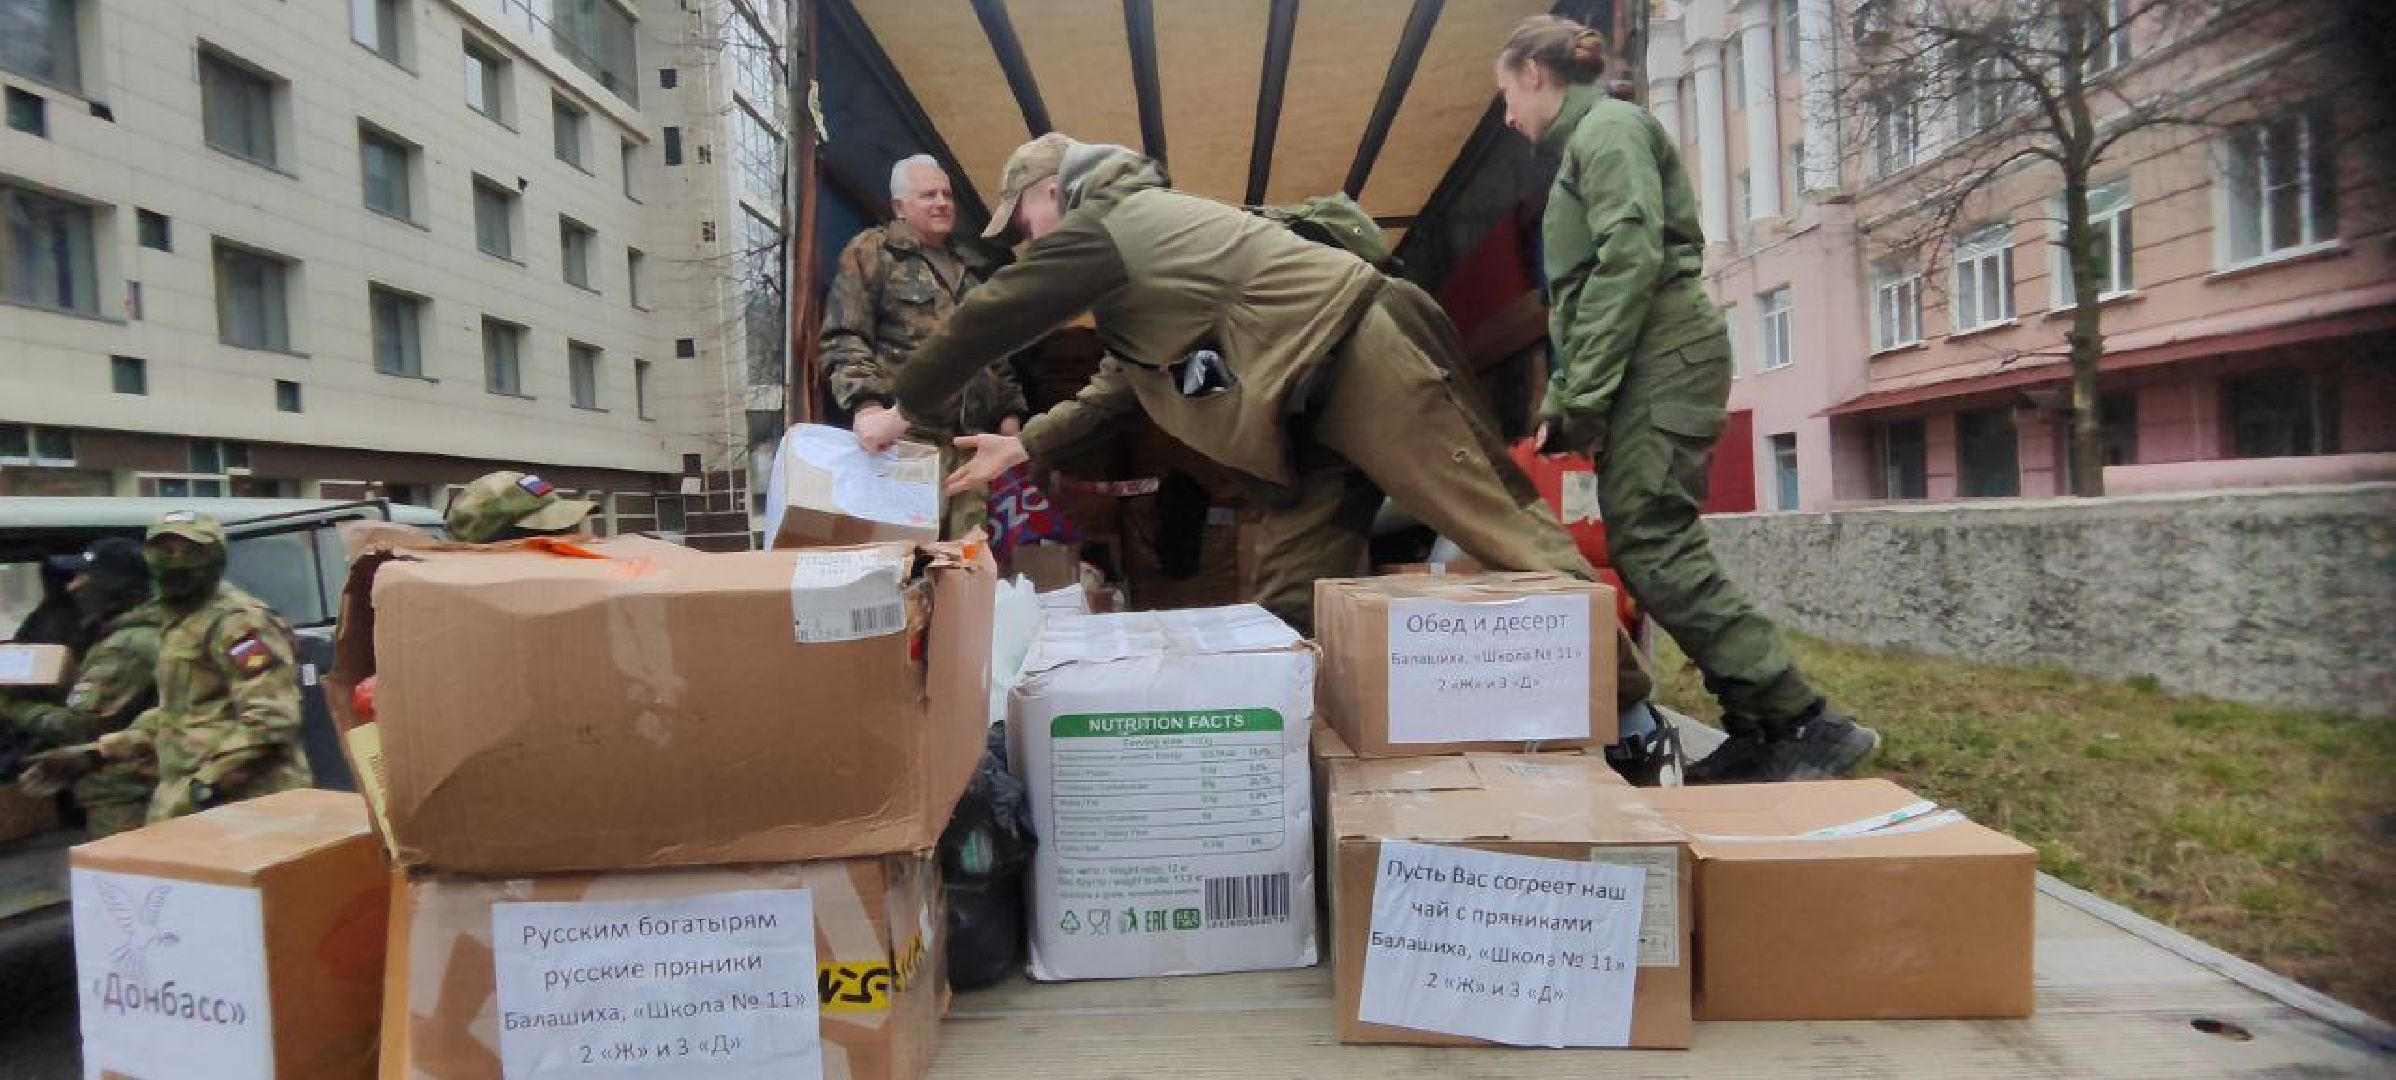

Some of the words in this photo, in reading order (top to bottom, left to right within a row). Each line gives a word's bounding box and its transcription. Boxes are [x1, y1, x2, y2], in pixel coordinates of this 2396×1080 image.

[1406, 613, 1467, 636] Обед
[1474, 617, 1488, 631] и
[1492, 613, 1568, 635] десерт
[1474, 648, 1532, 663] «Школа
[1535, 647, 1553, 661] №
[1557, 645, 1583, 659] 11»
[1437, 678, 1447, 690] 2
[1451, 677, 1481, 690] «Ж»
[1487, 678, 1496, 689] и
[1499, 676, 1508, 689] 3
[1512, 675, 1540, 689] «Д»
[1088, 716, 1184, 732] NUTRITION
[1188, 714, 1244, 729] FACTS
[1387, 859, 1446, 886] Пусть
[1452, 866, 1488, 888] Вас
[1493, 874, 1578, 896] согреет
[1582, 884, 1626, 901] наш
[522, 919, 630, 948] Русским
[639, 911, 777, 937] богатырям
[1410, 900, 1450, 920] чай
[1456, 905, 1466, 921] с
[1472, 908, 1593, 933] пряниками
[1371, 931, 1473, 961] Балашиха,
[1479, 942, 1557, 968] «Школа
[1563, 951, 1585, 969] №
[1591, 953, 1626, 973] 11»
[544, 962, 645, 991] русские
[655, 953, 762, 979] пряники
[1427, 972, 1438, 989] 2
[1444, 976, 1485, 994] «Ж»
[1492, 983, 1504, 997] и
[1509, 982, 1520, 999] 3
[1528, 983, 1564, 1004] «Д»
[92, 972, 247, 1025] «Донбасс»
[504, 1006, 626, 1031] Балашиха,
[633, 1000, 724, 1020] «Школа
[732, 993, 759, 1011] №
[767, 990, 806, 1009] 11»
[580, 1045, 593, 1064] 2
[600, 1041, 649, 1061] «Ж»
[656, 1041, 671, 1058] и
[678, 1037, 690, 1056] 3
[699, 1034, 744, 1057] «Д»
